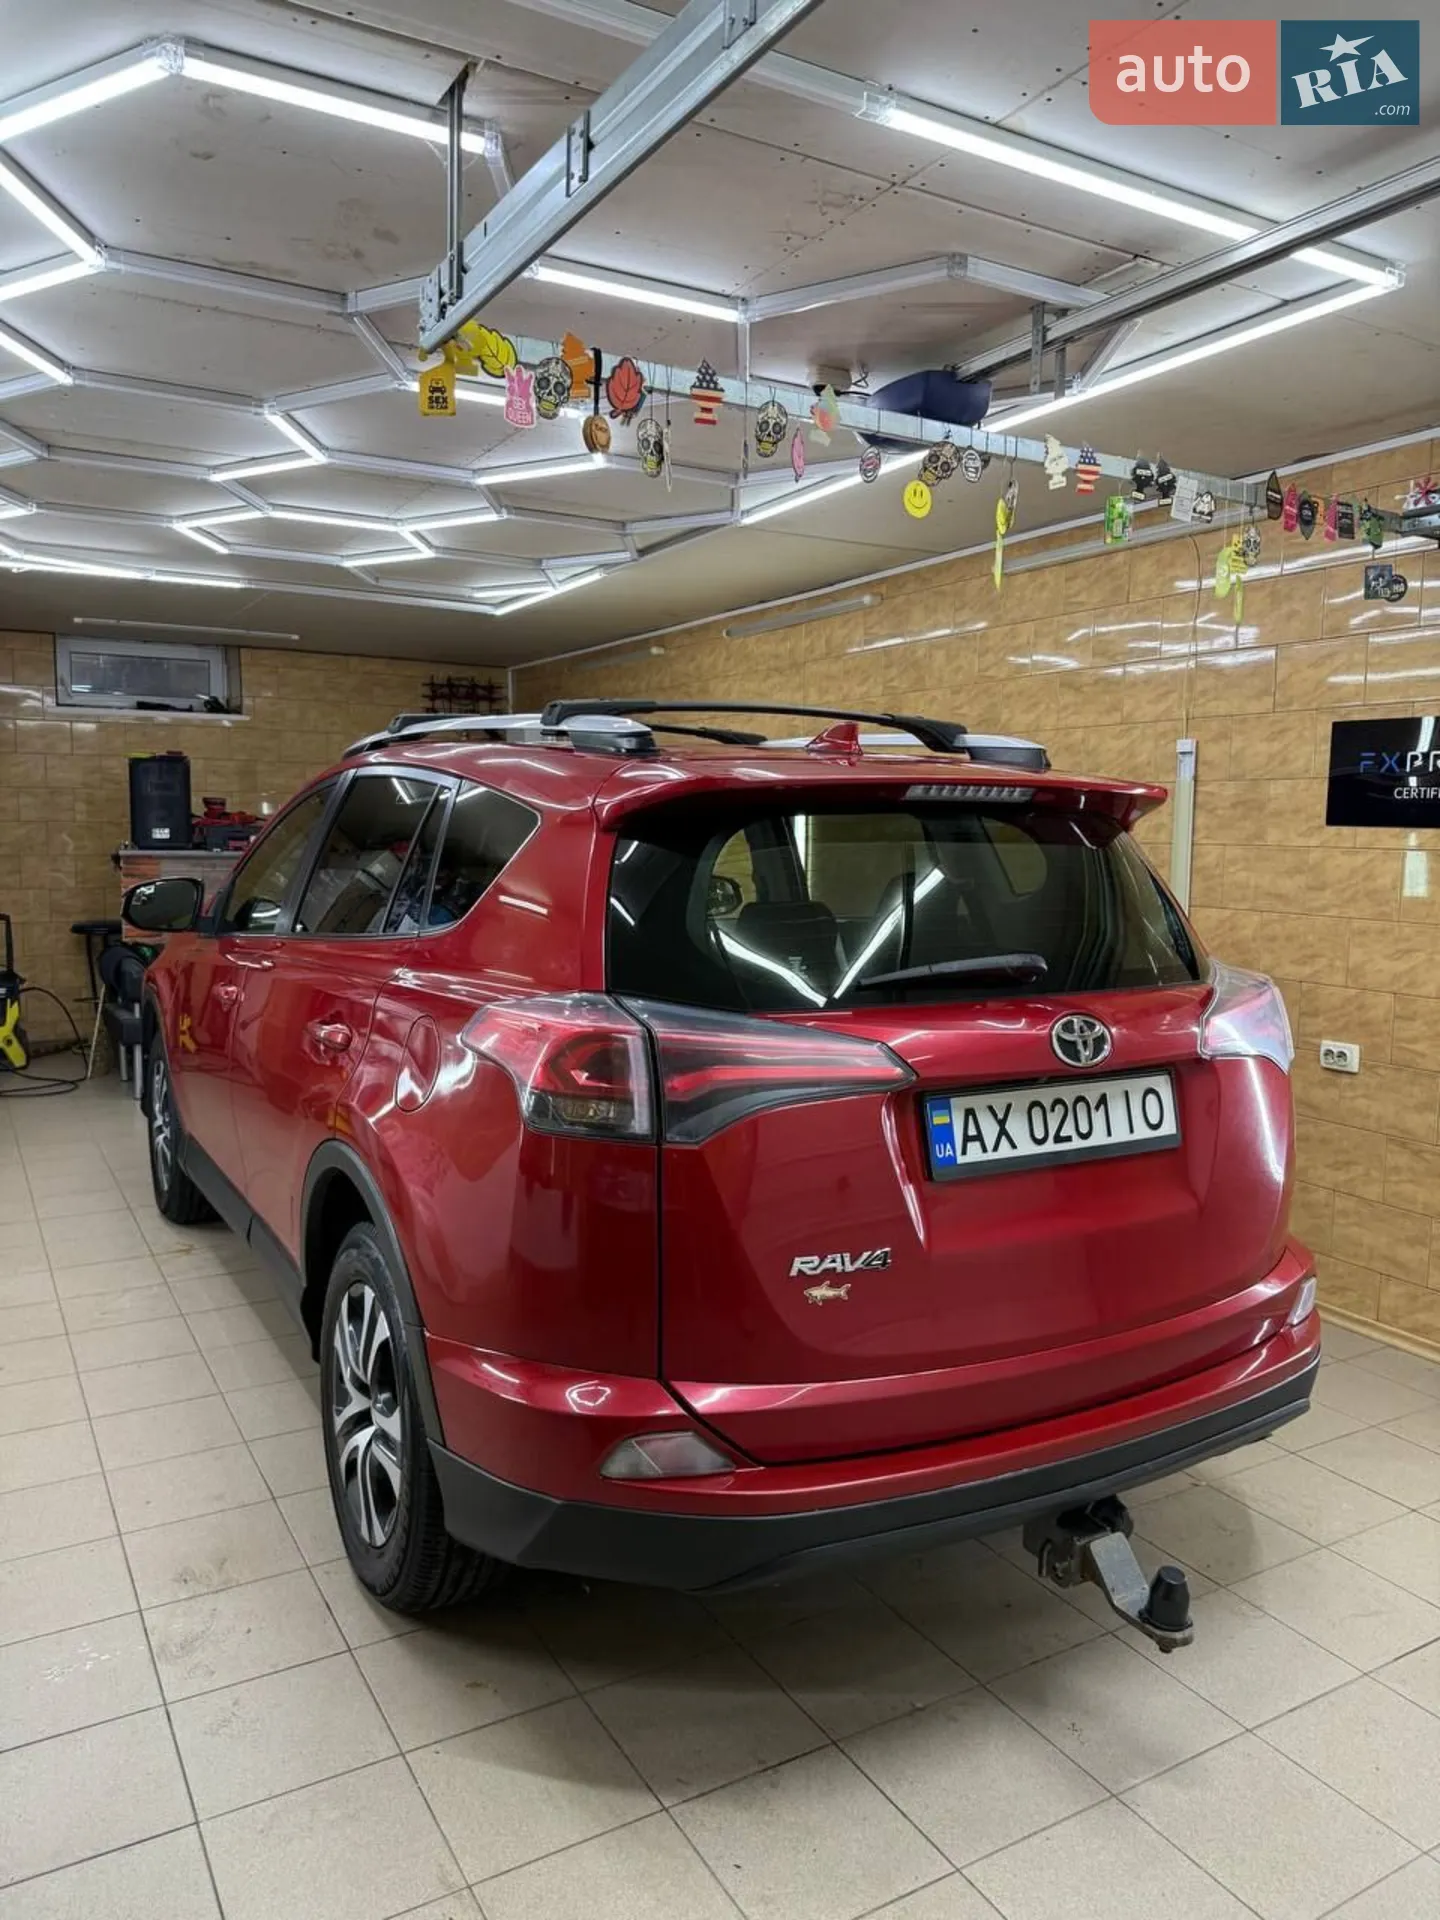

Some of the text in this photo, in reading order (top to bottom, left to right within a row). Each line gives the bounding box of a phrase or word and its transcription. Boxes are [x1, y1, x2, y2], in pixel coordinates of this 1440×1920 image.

[960, 1087, 1165, 1157] AX 0201 IO
[935, 1142, 955, 1158] UA
[788, 1247, 892, 1277] RAV4
